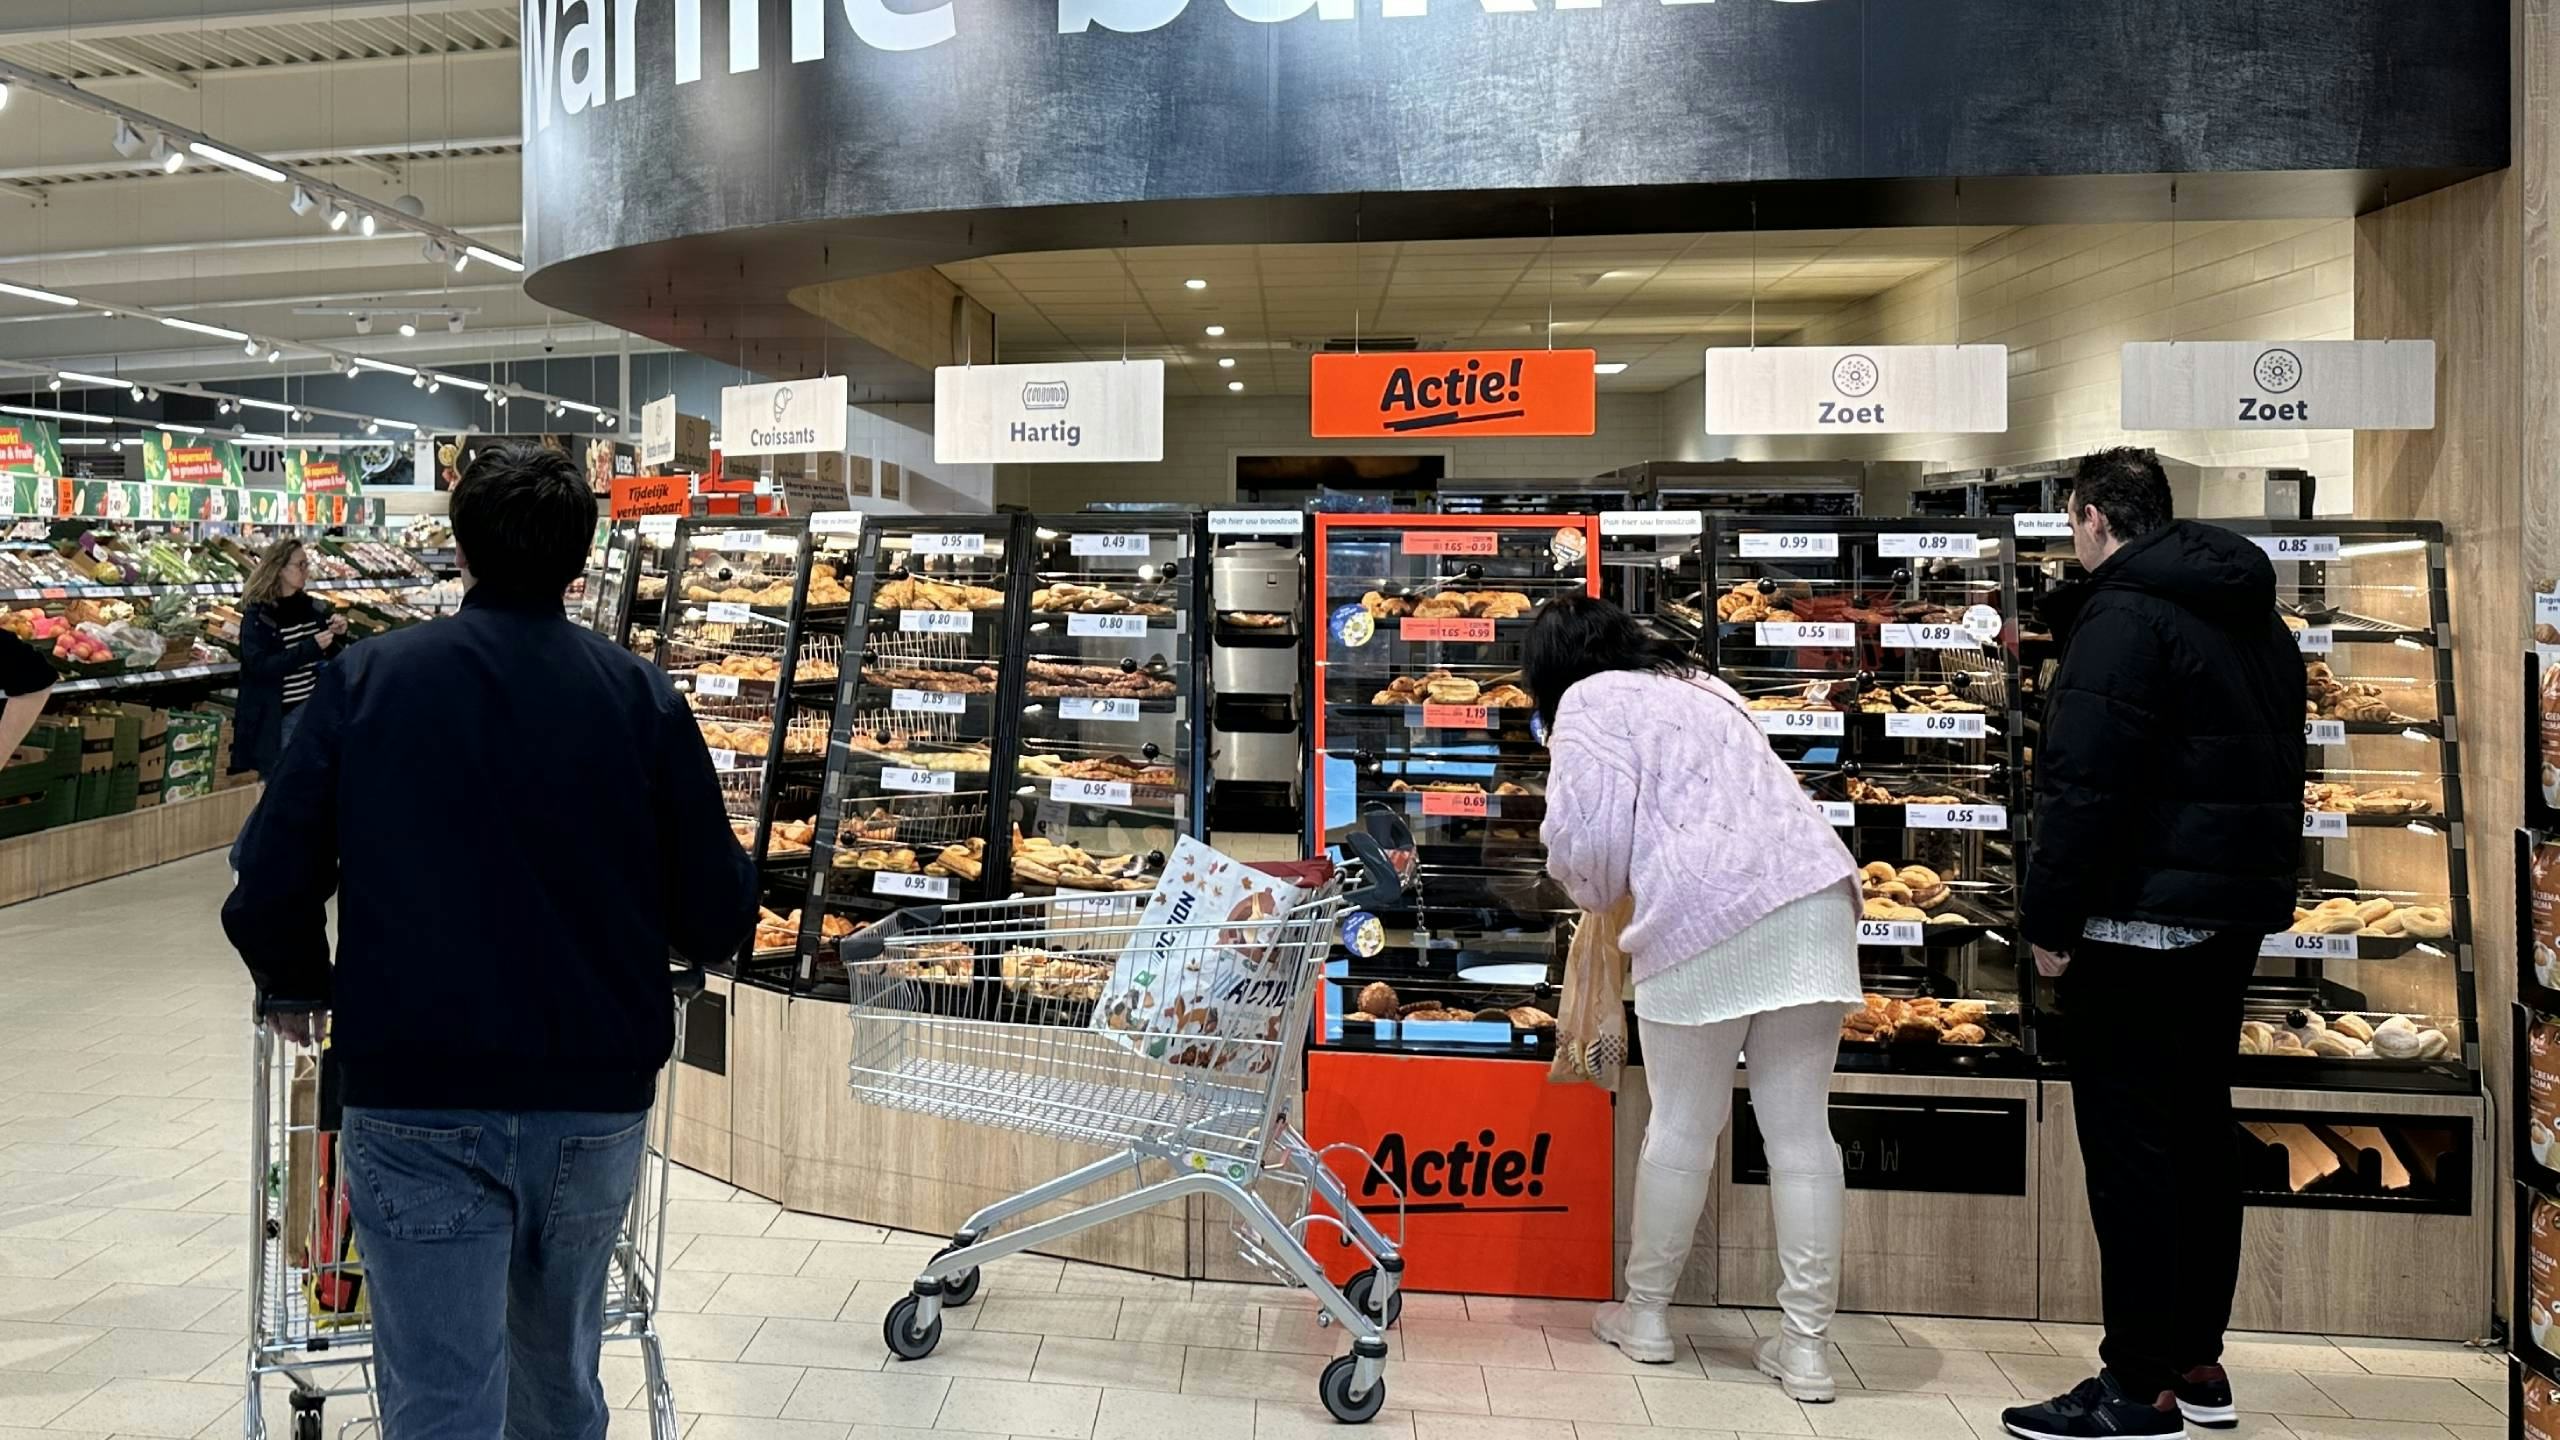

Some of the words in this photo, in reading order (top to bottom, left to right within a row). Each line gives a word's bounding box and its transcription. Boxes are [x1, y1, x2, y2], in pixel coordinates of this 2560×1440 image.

[1382, 360, 1523, 412] Actie!
[1818, 401, 1885, 425] Zoet
[2238, 398, 2308, 422] Zoet
[750, 427, 815, 447] Croissants
[1009, 422, 1081, 447] Hartig
[629, 484, 668, 502] Tijdelijk
[2037, 520, 2054, 528] hier
[941, 535, 962, 547] 0.95
[1102, 535, 1126, 549] 0.49
[1779, 536, 1808, 550] 0.99
[1918, 536, 1947, 551] 0.89
[2278, 538, 2308, 553] 0.85
[929, 613, 950, 625] 0.80
[1099, 616, 1123, 629] 0.80
[1798, 625, 1825, 640] 0.55
[1921, 626, 1950, 641] 0.89
[922, 692, 944, 705] 0.89
[1466, 708, 1486, 719] 1.19
[1786, 714, 1814, 727] 0.59
[1926, 716, 1955, 731] 0.69
[911, 771, 932, 785] 0.95
[1083, 783, 1107, 796] 0.95
[1463, 795, 1485, 807] 0.69
[1947, 810, 1974, 823] 0.55
[904, 876, 926, 889] 0.95
[1862, 924, 1890, 937] 0.55
[2295, 936, 2323, 950] 0.55
[1361, 1128, 1551, 1197] Actie!
